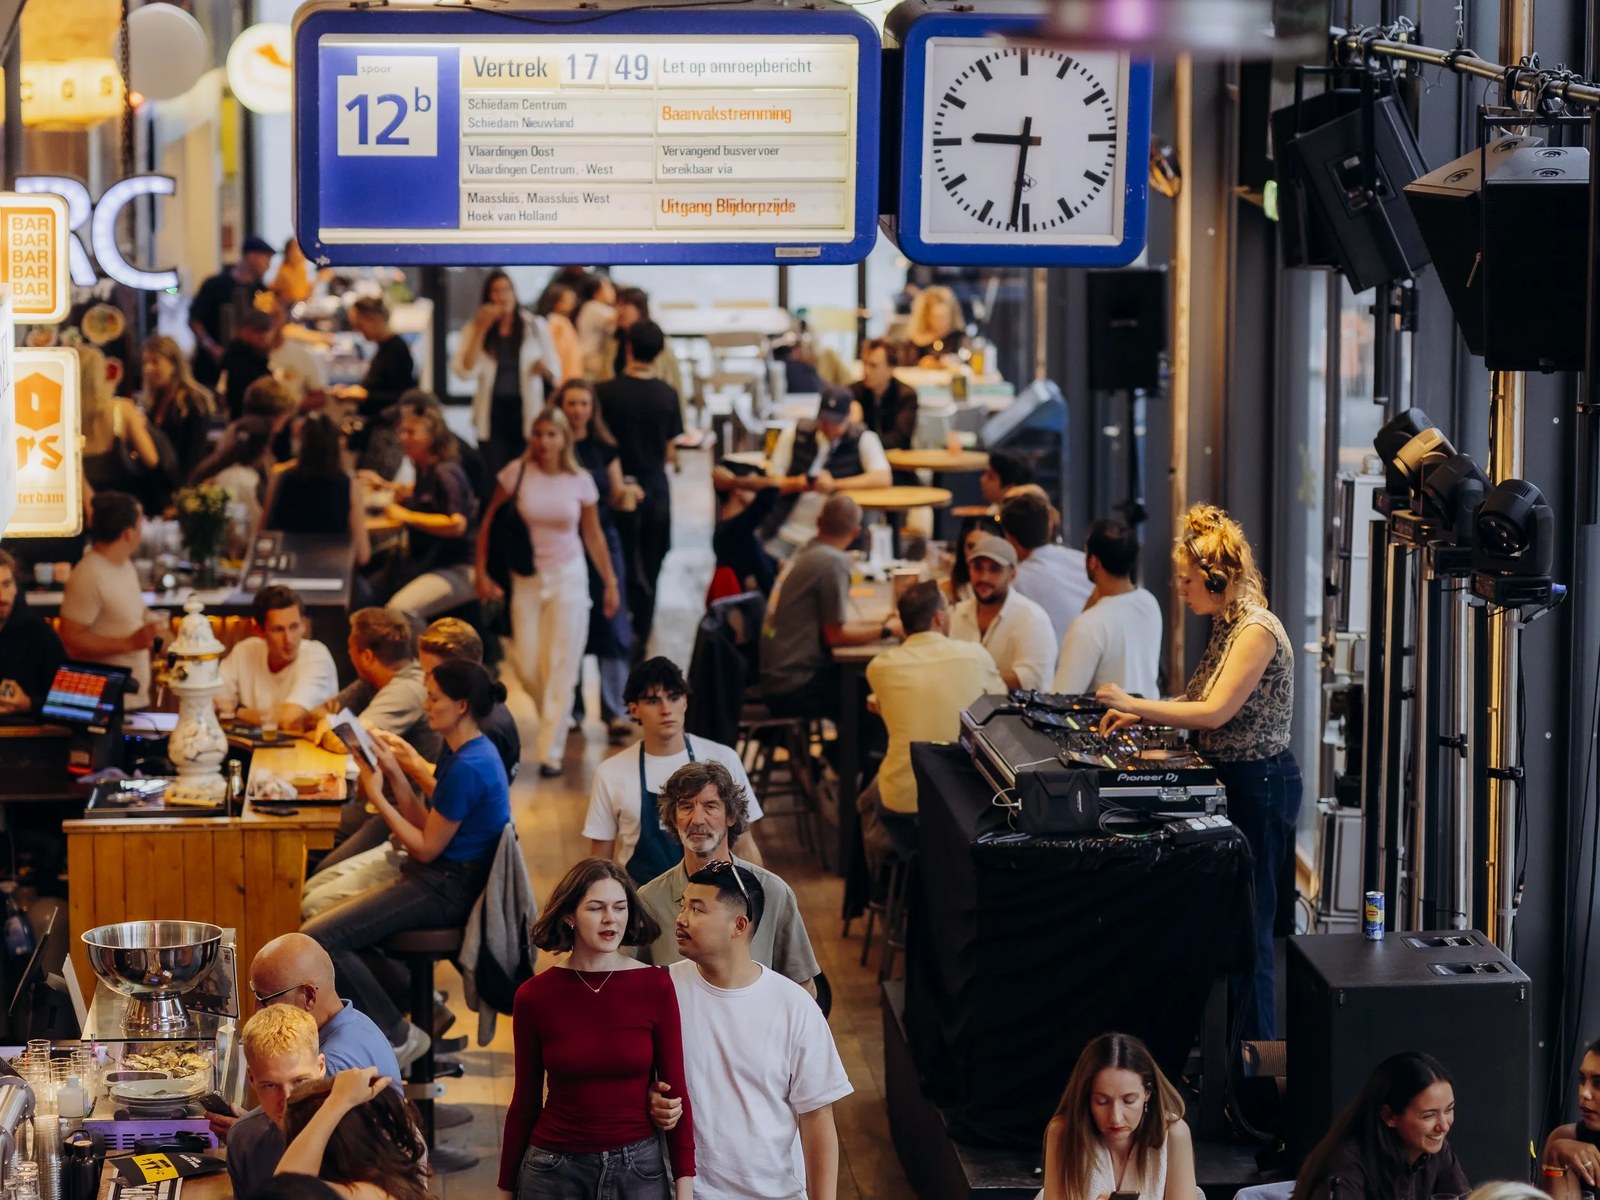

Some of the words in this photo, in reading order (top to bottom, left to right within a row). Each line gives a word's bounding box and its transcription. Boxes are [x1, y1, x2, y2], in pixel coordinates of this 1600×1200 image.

[361, 65, 392, 74] spoor
[473, 56, 548, 78] Vertrek
[567, 53, 599, 80] 17
[615, 54, 649, 81] 49
[662, 58, 684, 74] Let
[689, 64, 706, 77] op
[710, 58, 812, 77] omroepbericht
[468, 98, 519, 111] Schiedam
[522, 98, 567, 110] Centrum
[662, 105, 792, 124] Baanvakstremming
[468, 116, 519, 129] Schiedam
[522, 116, 574, 129] Nieuwland
[468, 145, 528, 160] Vlaardingen
[531, 145, 555, 157] Oost
[662, 145, 721, 158] Vervangend
[723, 145, 780, 157] busvervoer
[468, 163, 527, 177] Vlaardingen
[662, 163, 714, 175] bereikbaar
[718, 163, 733, 175] via
[467, 192, 524, 205] Maassluis,
[527, 192, 579, 204] Maassluis
[583, 192, 611, 204] West
[660, 198, 712, 217] Uitgang
[716, 198, 797, 217] Blijdorpzijde
[467, 210, 494, 222] Hoek
[498, 212, 516, 222] van
[519, 209, 559, 222] Holland
[12, 217, 49, 231] BAR
[12, 233, 49, 247] BAR
[12, 250, 49, 263] BAR
[12, 266, 49, 279] BAR
[12, 282, 49, 296] BAR
[1117, 773, 1164, 782] Pioneer
